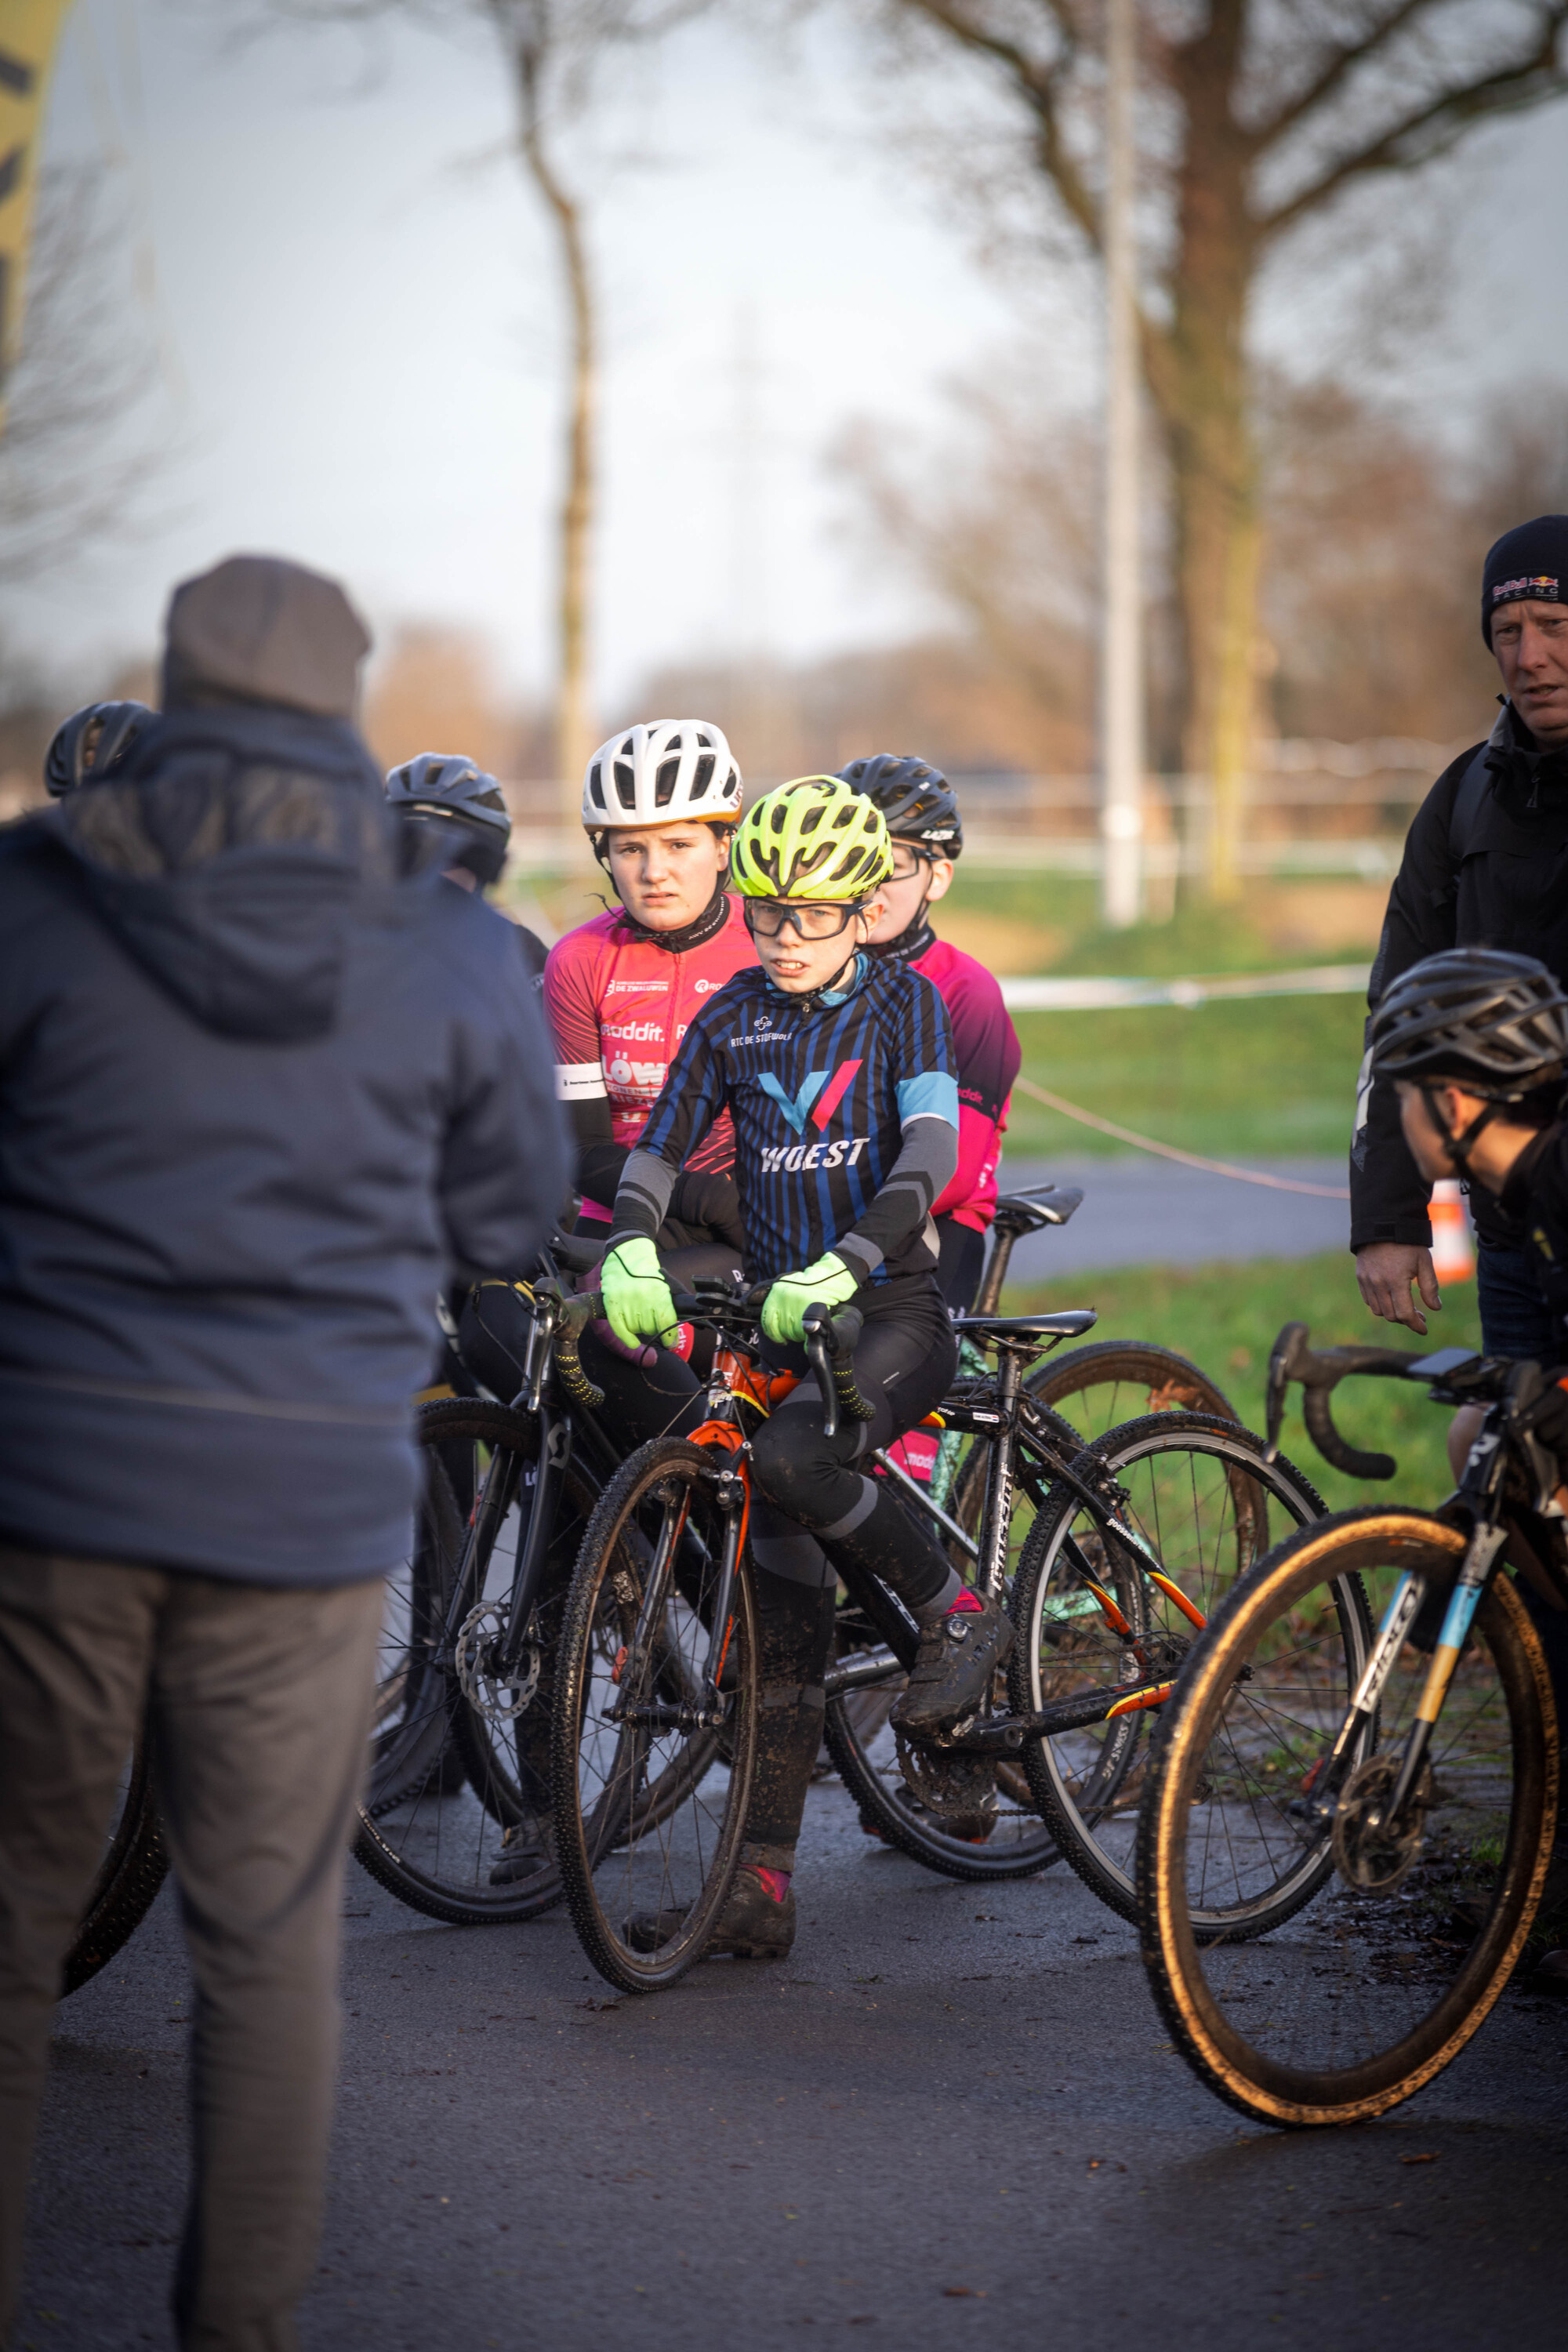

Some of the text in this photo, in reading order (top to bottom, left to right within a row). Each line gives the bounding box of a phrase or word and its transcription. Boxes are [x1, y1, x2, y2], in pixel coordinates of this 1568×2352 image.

[1493, 577, 1528, 596] Red Bull
[1493, 587, 1559, 602] RACING
[731, 1037, 744, 1047] RTC
[745, 1036, 754, 1045] DE
[760, 1138, 871, 1173] WOEST
